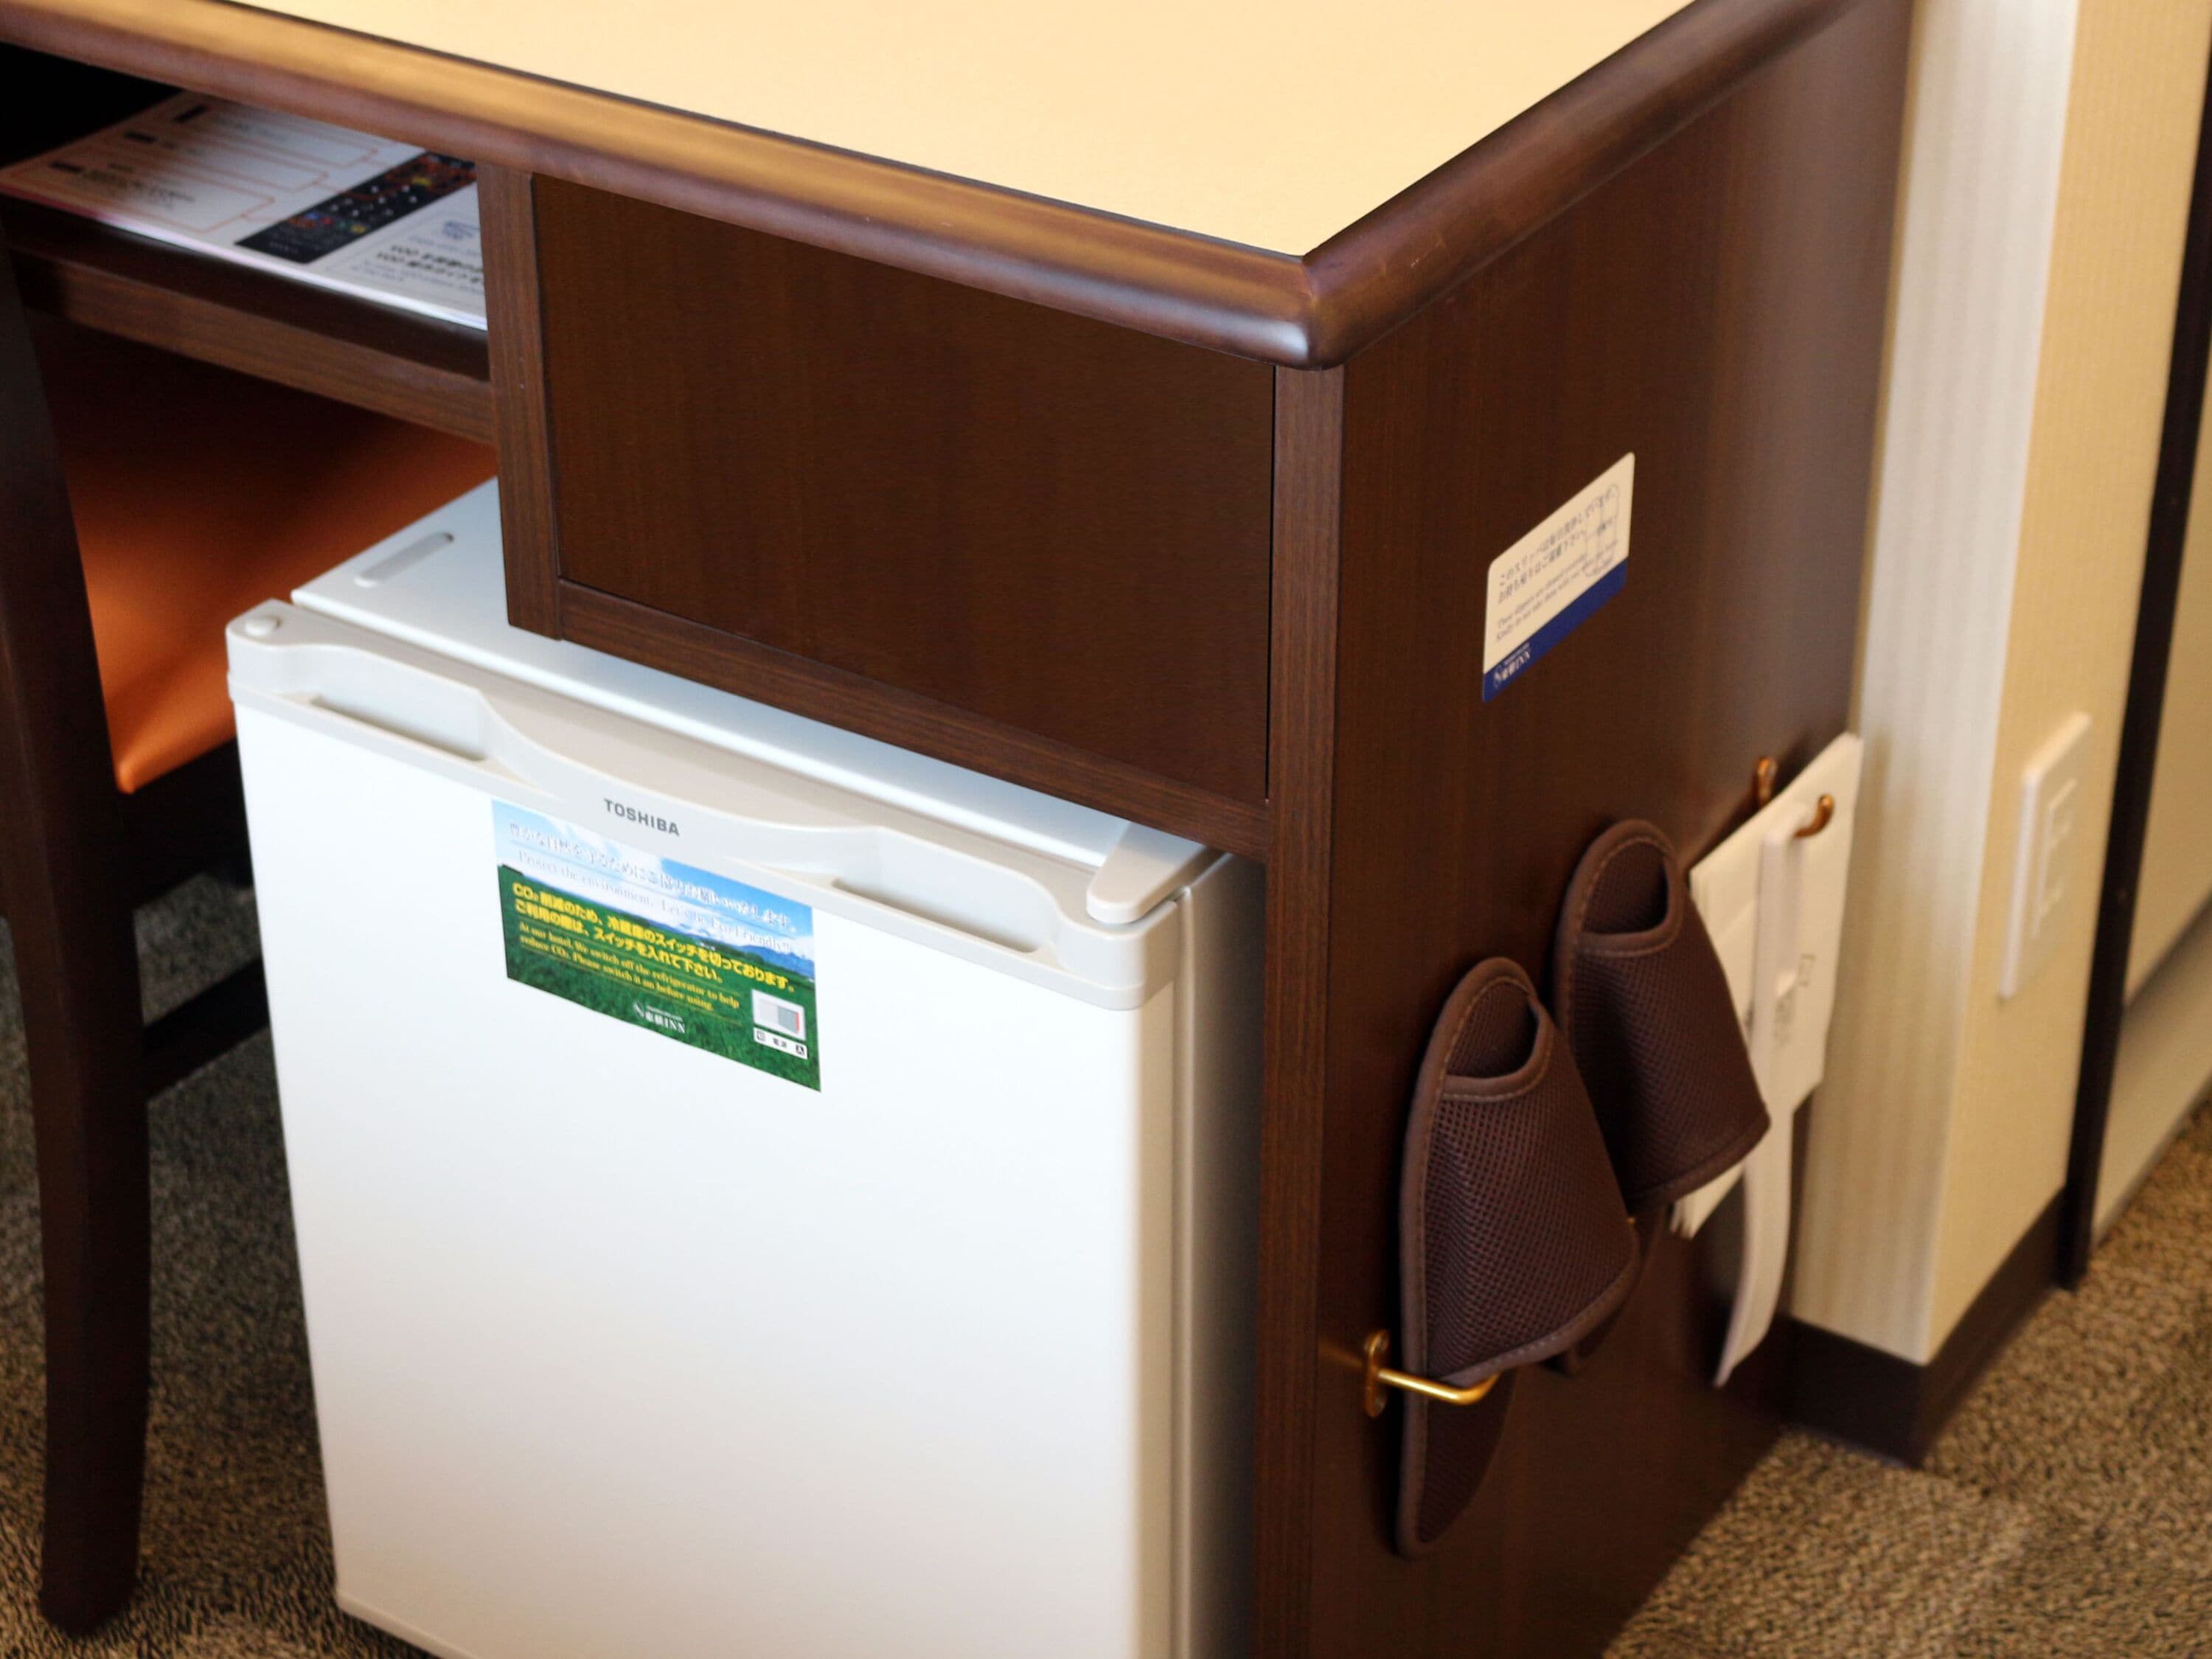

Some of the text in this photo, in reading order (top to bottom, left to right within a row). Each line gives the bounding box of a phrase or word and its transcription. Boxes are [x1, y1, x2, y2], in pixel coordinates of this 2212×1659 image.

[604, 798, 680, 836] TOSHIBA
[636, 962, 650, 976] the
[707, 990, 717, 1001] to
[718, 992, 739, 1010] help
